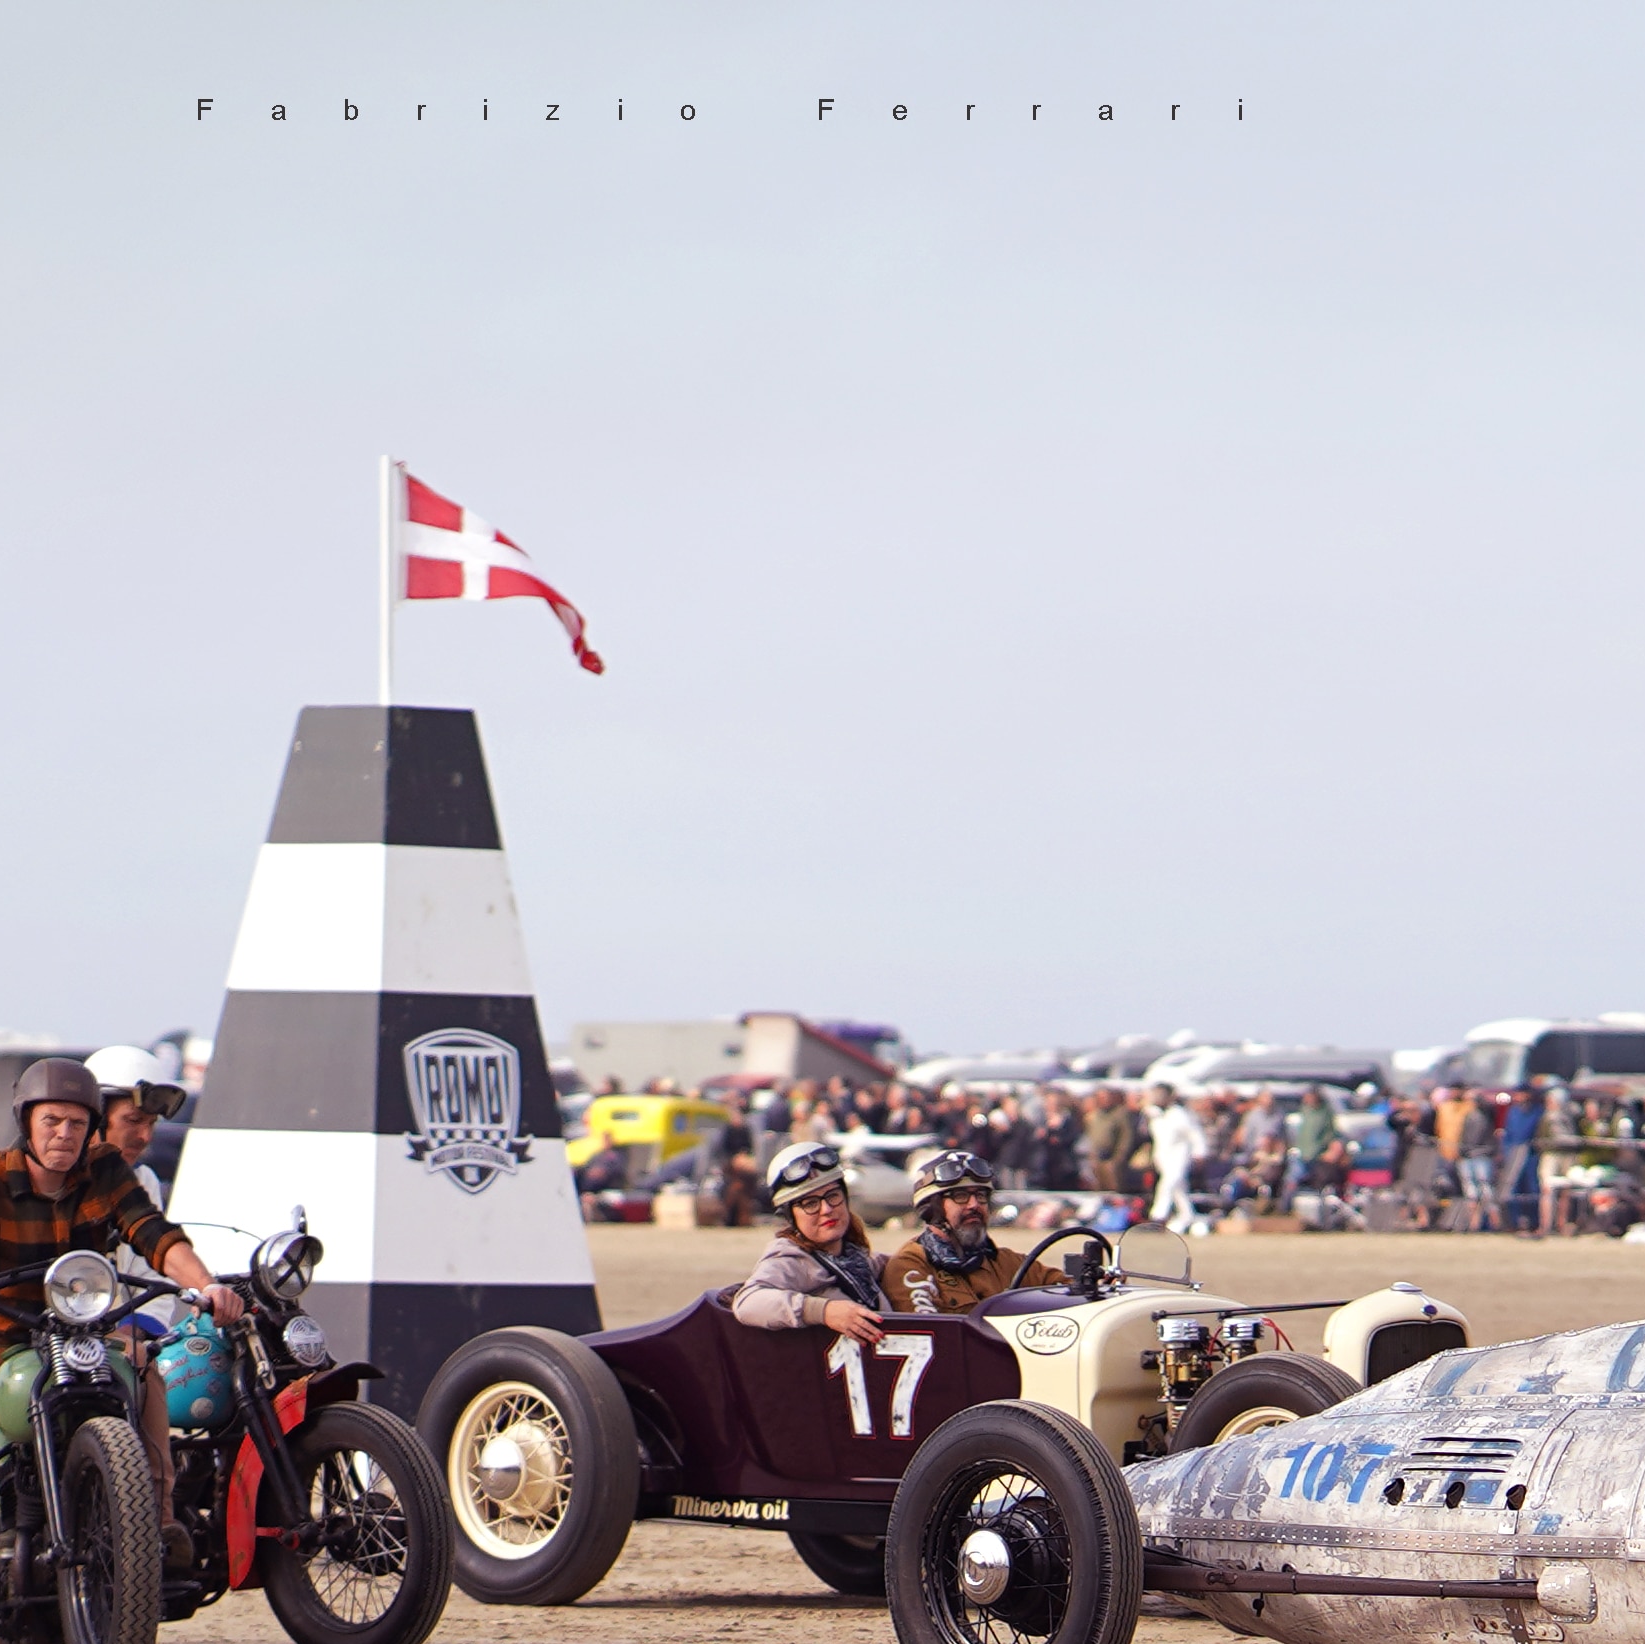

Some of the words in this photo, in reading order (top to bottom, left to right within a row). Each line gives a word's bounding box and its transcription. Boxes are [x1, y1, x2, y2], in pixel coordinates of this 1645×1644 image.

[827, 1332, 934, 1437] 17
[1280, 1441, 1396, 1504] 107
[672, 1495, 759, 1519] Minerva
[762, 1500, 790, 1520] oil
